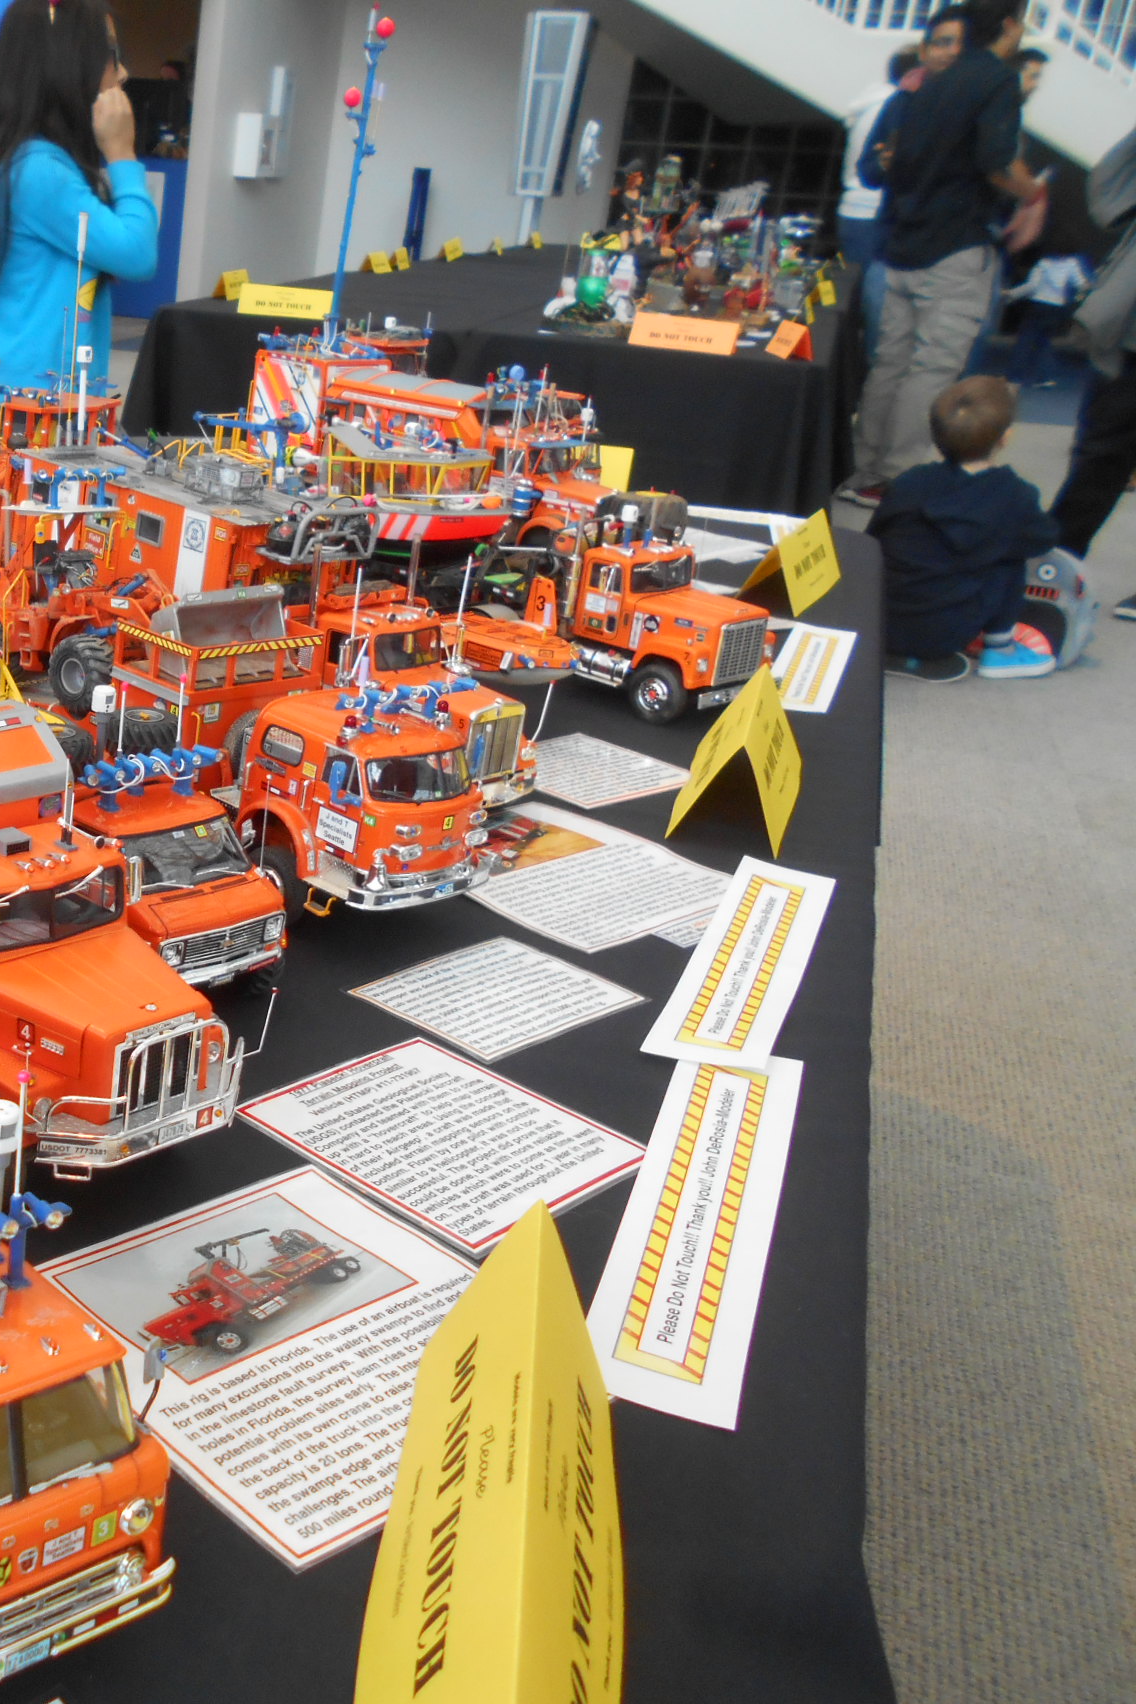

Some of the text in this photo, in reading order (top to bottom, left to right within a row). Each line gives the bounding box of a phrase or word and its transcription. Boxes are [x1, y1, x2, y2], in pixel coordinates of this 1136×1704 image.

[286, 302, 312, 310] TOUCH
[683, 335, 713, 344] TOUCH
[536, 595, 545, 611] 3
[319, 819, 353, 839] Specialists
[324, 830, 345, 845] Seattle
[331, 816, 343, 825] and
[708, 1017, 725, 1033] Please
[720, 998, 733, 1007] Not
[733, 960, 749, 976] Thank
[20, 1024, 31, 1040] 4
[199, 1109, 210, 1125] 4
[293, 1072, 450, 1138] The United States Geological Society
[41, 1143, 71, 1153] USDOT
[444, 1146, 604, 1229] types of terrain throughout the United
[657, 1088, 734, 1343] Please Do Not Touch!! Thank you!! John DeRosia-Modeler
[159, 1402, 189, 1416] This
[189, 1393, 209, 1404] rig
[206, 1387, 220, 1395] is
[218, 1368, 256, 1389] based
[255, 1364, 270, 1372] in
[268, 1346, 312, 1366] Florida.
[313, 1334, 337, 1344] The
[337, 1324, 358, 1335] use
[358, 1317, 370, 1325] of
[370, 1312, 385, 1320] an
[385, 1295, 421, 1314] airboat
[431, 1273, 471, 1293] required
[172, 1417, 191, 1429] for
[193, 1401, 227, 1420] many
[228, 1371, 291, 1403] excursions
[289, 1360, 314, 1373] into
[313, 1351, 333, 1362] the
[333, 1334, 370, 1352] watery
[370, 1315, 413, 1336] swamps
[422, 1299, 445, 1311] find
[185, 1336, 400, 1440] in the limestone fault surveys. With the
[198, 1344, 417, 1451] holes in Florida, the survey team tries to
[475, 1424, 495, 1500] Please
[574, 1375, 595, 1544] TOUCH
[98, 1520, 109, 1537] 3
[412, 1333, 478, 1700] DO NOT TOUCH
[572, 1531, 594, 1670] NOT
